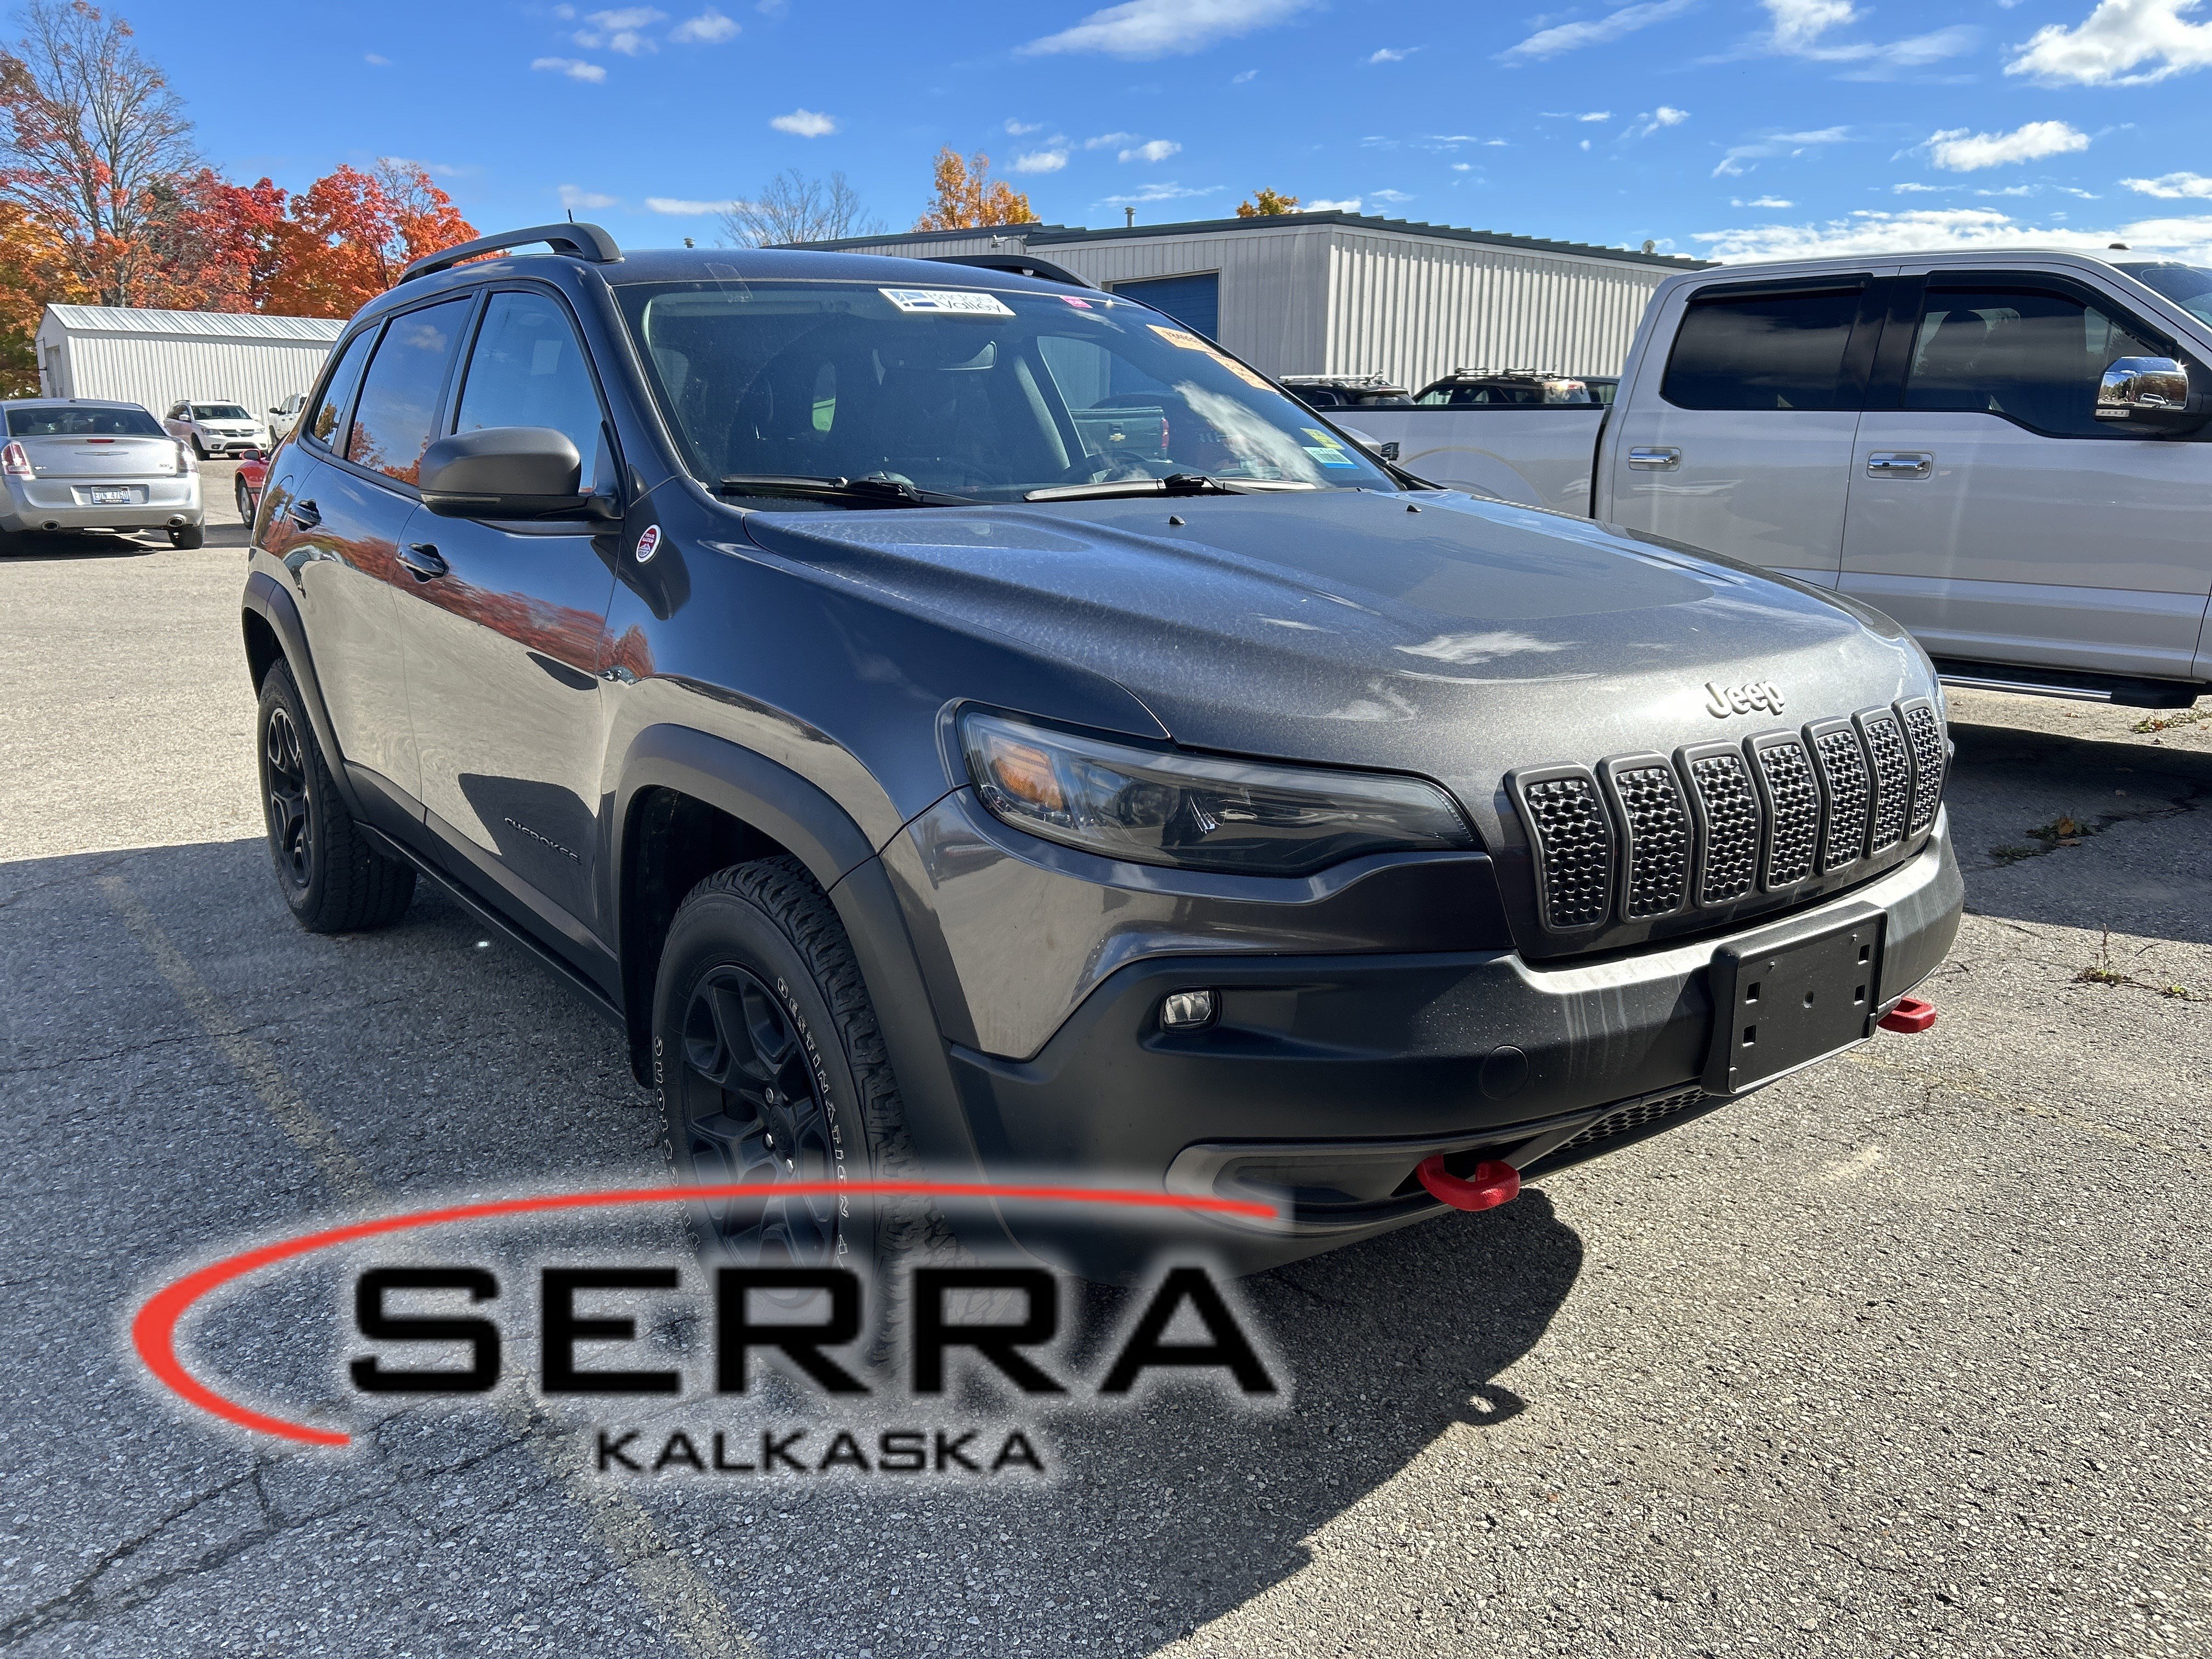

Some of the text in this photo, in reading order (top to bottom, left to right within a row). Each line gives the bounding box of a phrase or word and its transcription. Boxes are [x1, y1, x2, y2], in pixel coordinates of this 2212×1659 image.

[925, 292, 992, 304] Bridge
[934, 300, 1001, 313] Valley
[1705, 681, 1785, 719] Jeep
[504, 817, 581, 865] CHEROKEE
[777, 977, 849, 1218] DESTINATION
